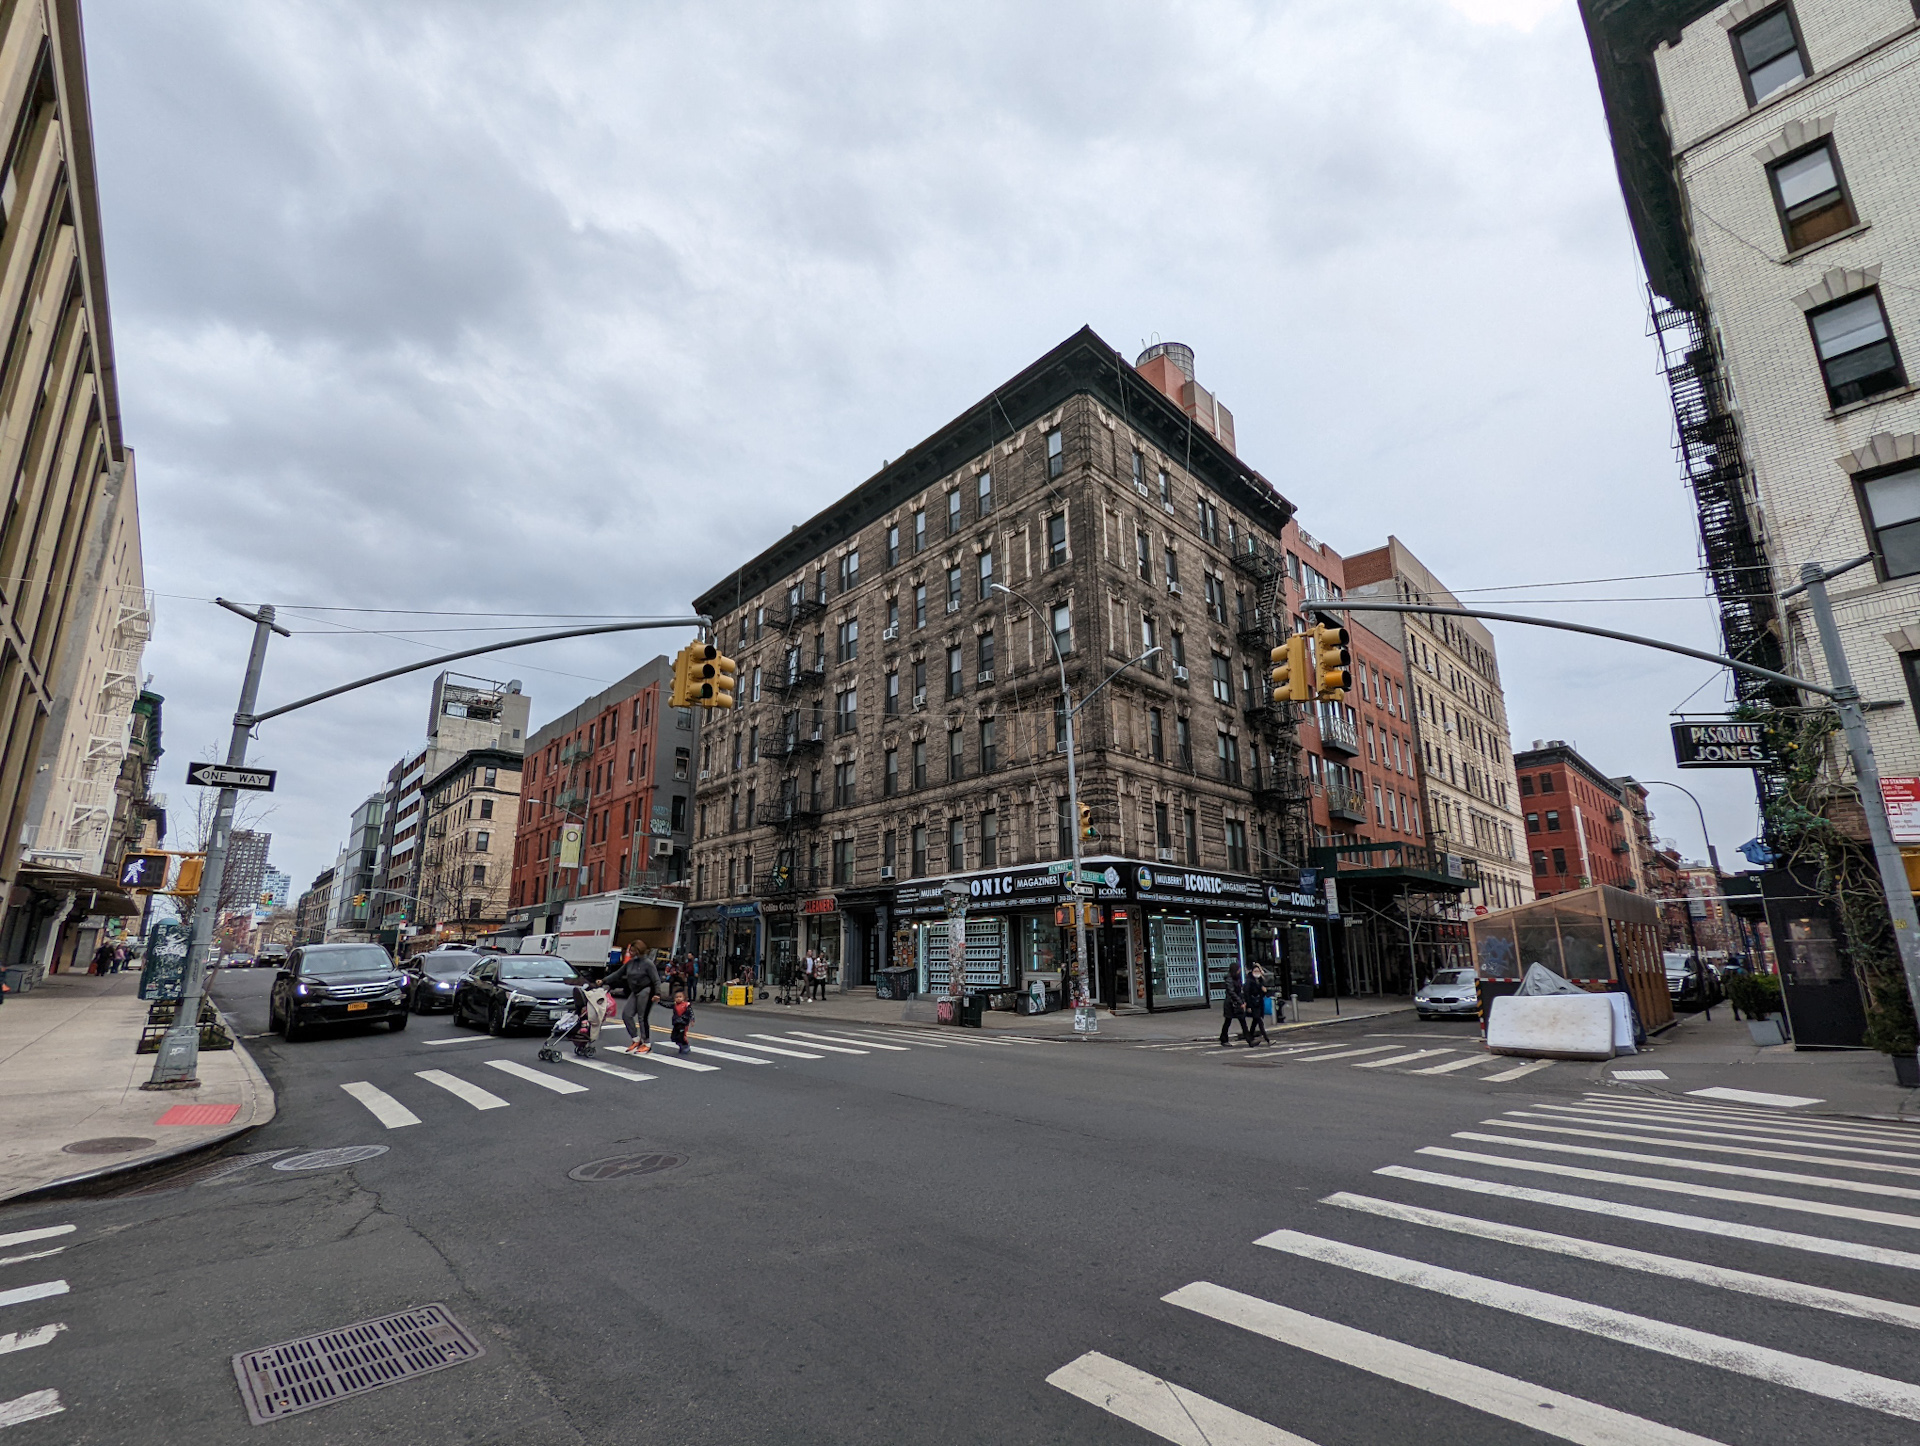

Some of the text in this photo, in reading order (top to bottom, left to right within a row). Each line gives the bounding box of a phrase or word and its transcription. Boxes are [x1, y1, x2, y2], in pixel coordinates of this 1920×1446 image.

[1690, 726, 1763, 744] PASQUALE
[1694, 745, 1764, 761] JONES
[202, 770, 264, 784] ONE WAY
[920, 887, 944, 898] MULBER
[970, 876, 1013, 897] ONIC
[1016, 875, 1057, 888] MAGAZINES
[1098, 887, 1127, 895] ICONIC
[1156, 874, 1183, 886] MULBERRY
[1184, 873, 1222, 894] ICONIC
[1222, 881, 1247, 894] MAGAZINES
[806, 898, 834, 913] CLEANERS
[1291, 892, 1316, 907] ICONIC
